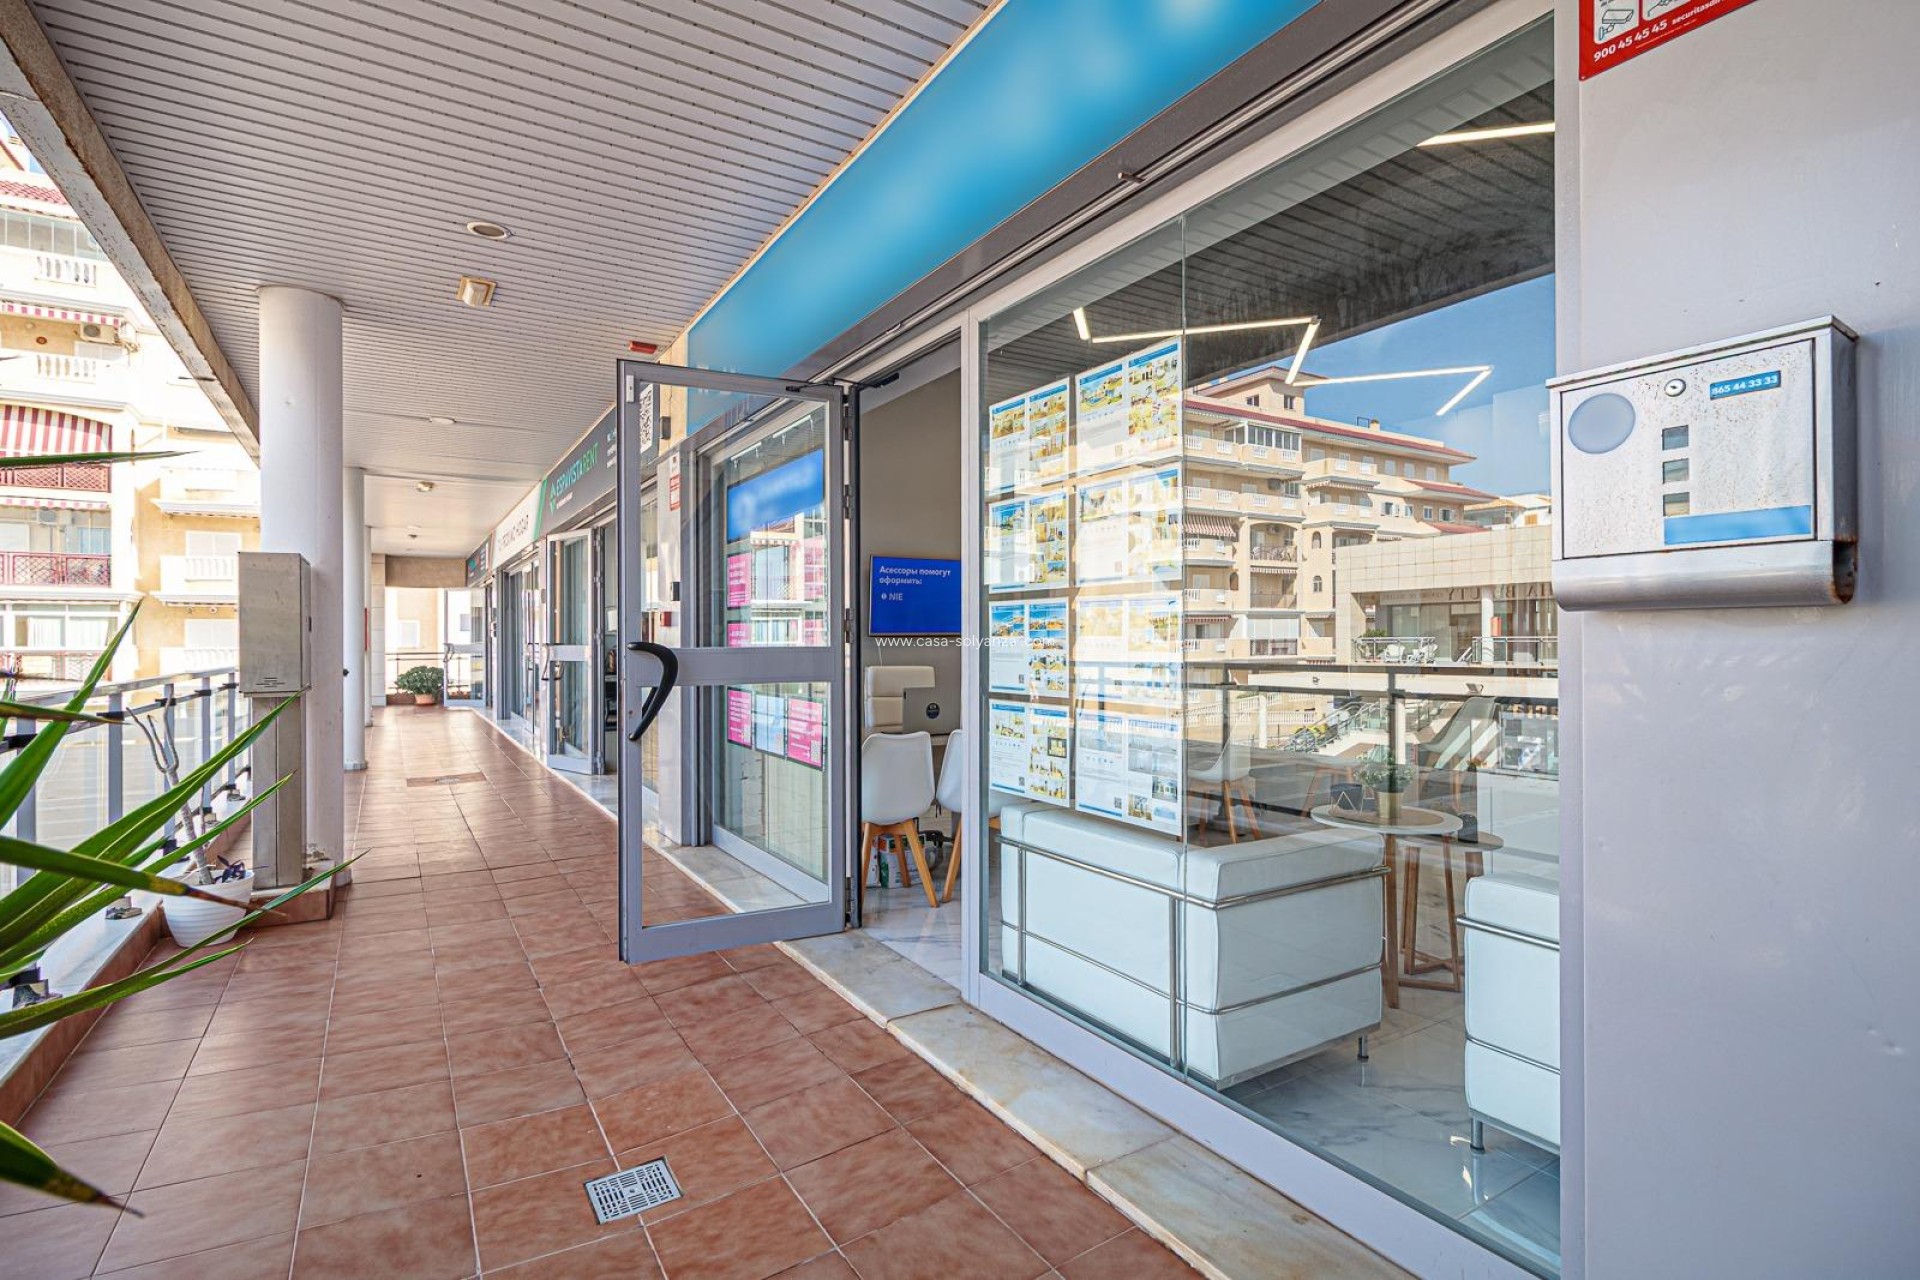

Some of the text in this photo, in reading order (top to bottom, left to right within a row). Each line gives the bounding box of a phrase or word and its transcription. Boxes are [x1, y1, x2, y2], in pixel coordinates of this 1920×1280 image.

[1594, 45, 1616, 62] 900
[1618, 35, 1632, 49] 45
[1634, 28, 1649, 41] 45
[1651, 18, 1668, 33] 45
[1733, 381, 1746, 390] 44
[1748, 378, 1762, 388] 33
[1764, 374, 1778, 384] 33
[880, 565, 951, 578] Асессоры помогут
[879, 575, 923, 586] оформить:
[888, 592, 904, 601] NIE
